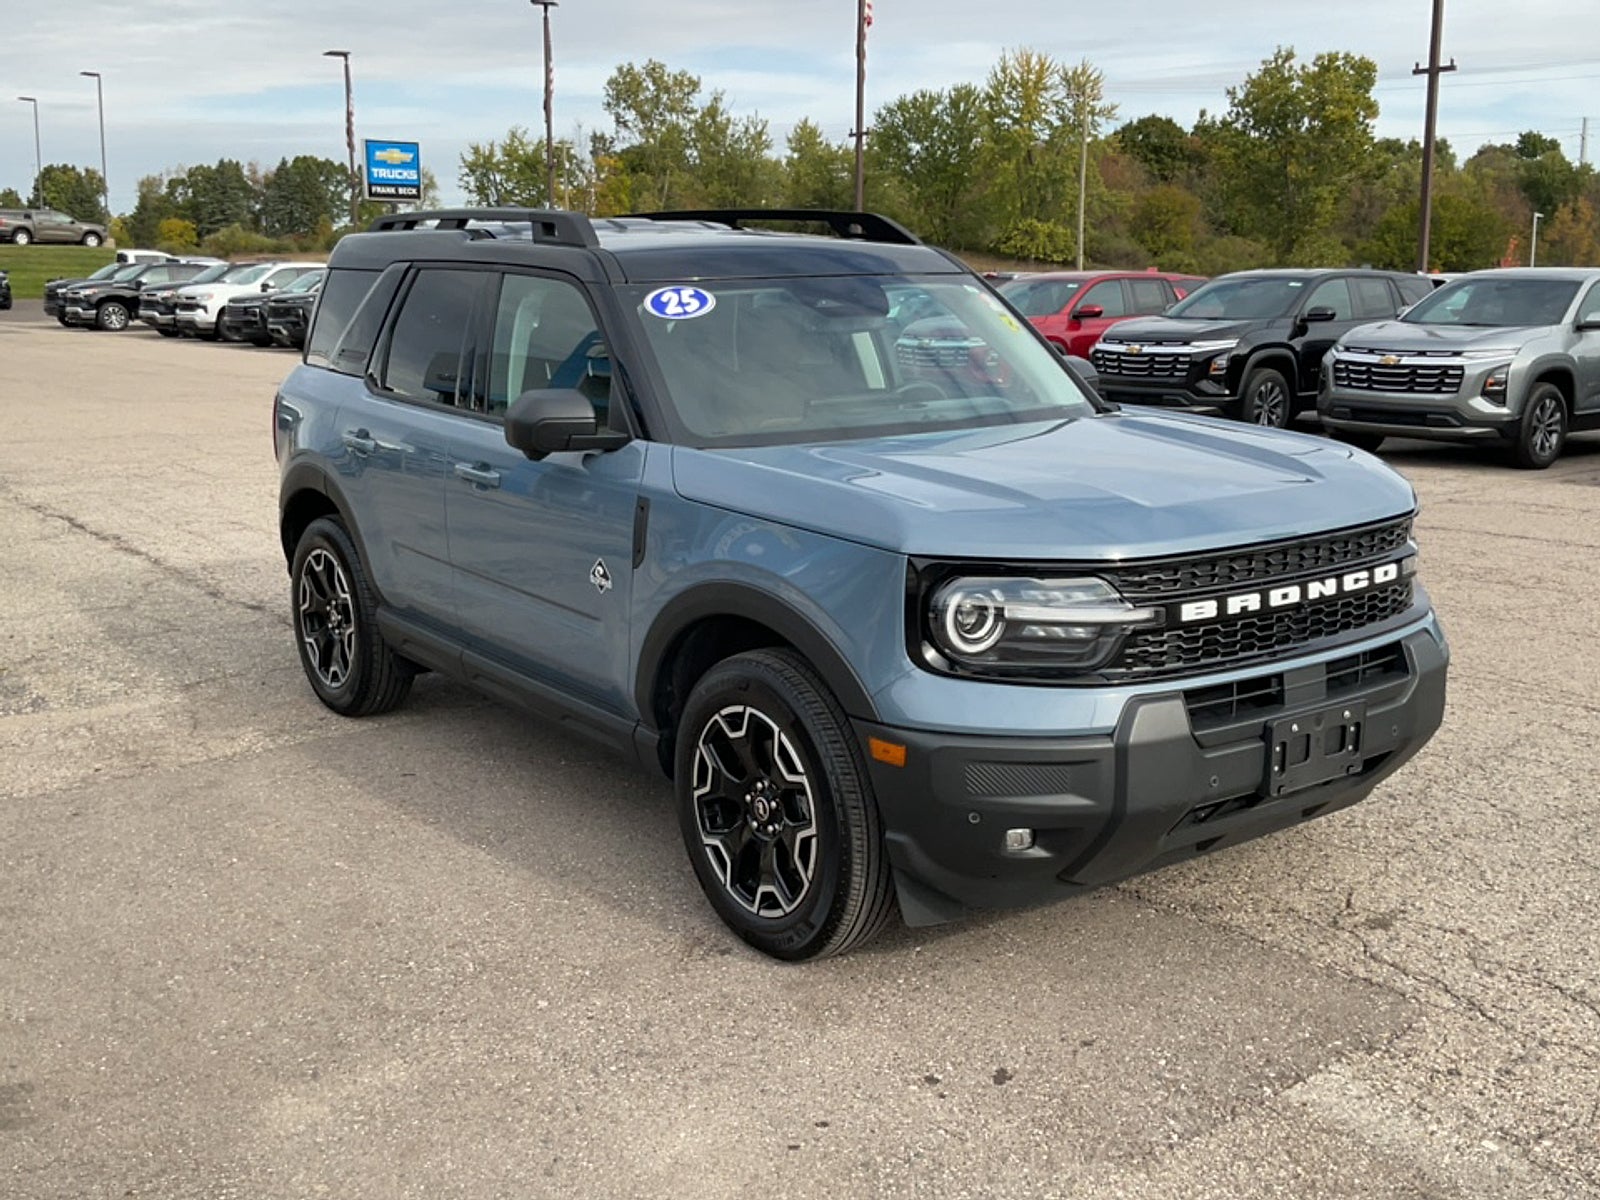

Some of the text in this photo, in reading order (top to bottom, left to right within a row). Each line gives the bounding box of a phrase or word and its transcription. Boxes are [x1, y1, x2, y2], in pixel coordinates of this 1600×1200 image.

[371, 168, 418, 180] TRUCKS
[371, 186, 418, 196] FRANK BECK
[660, 289, 700, 315] 25
[1181, 563, 1398, 622] BRONCO
